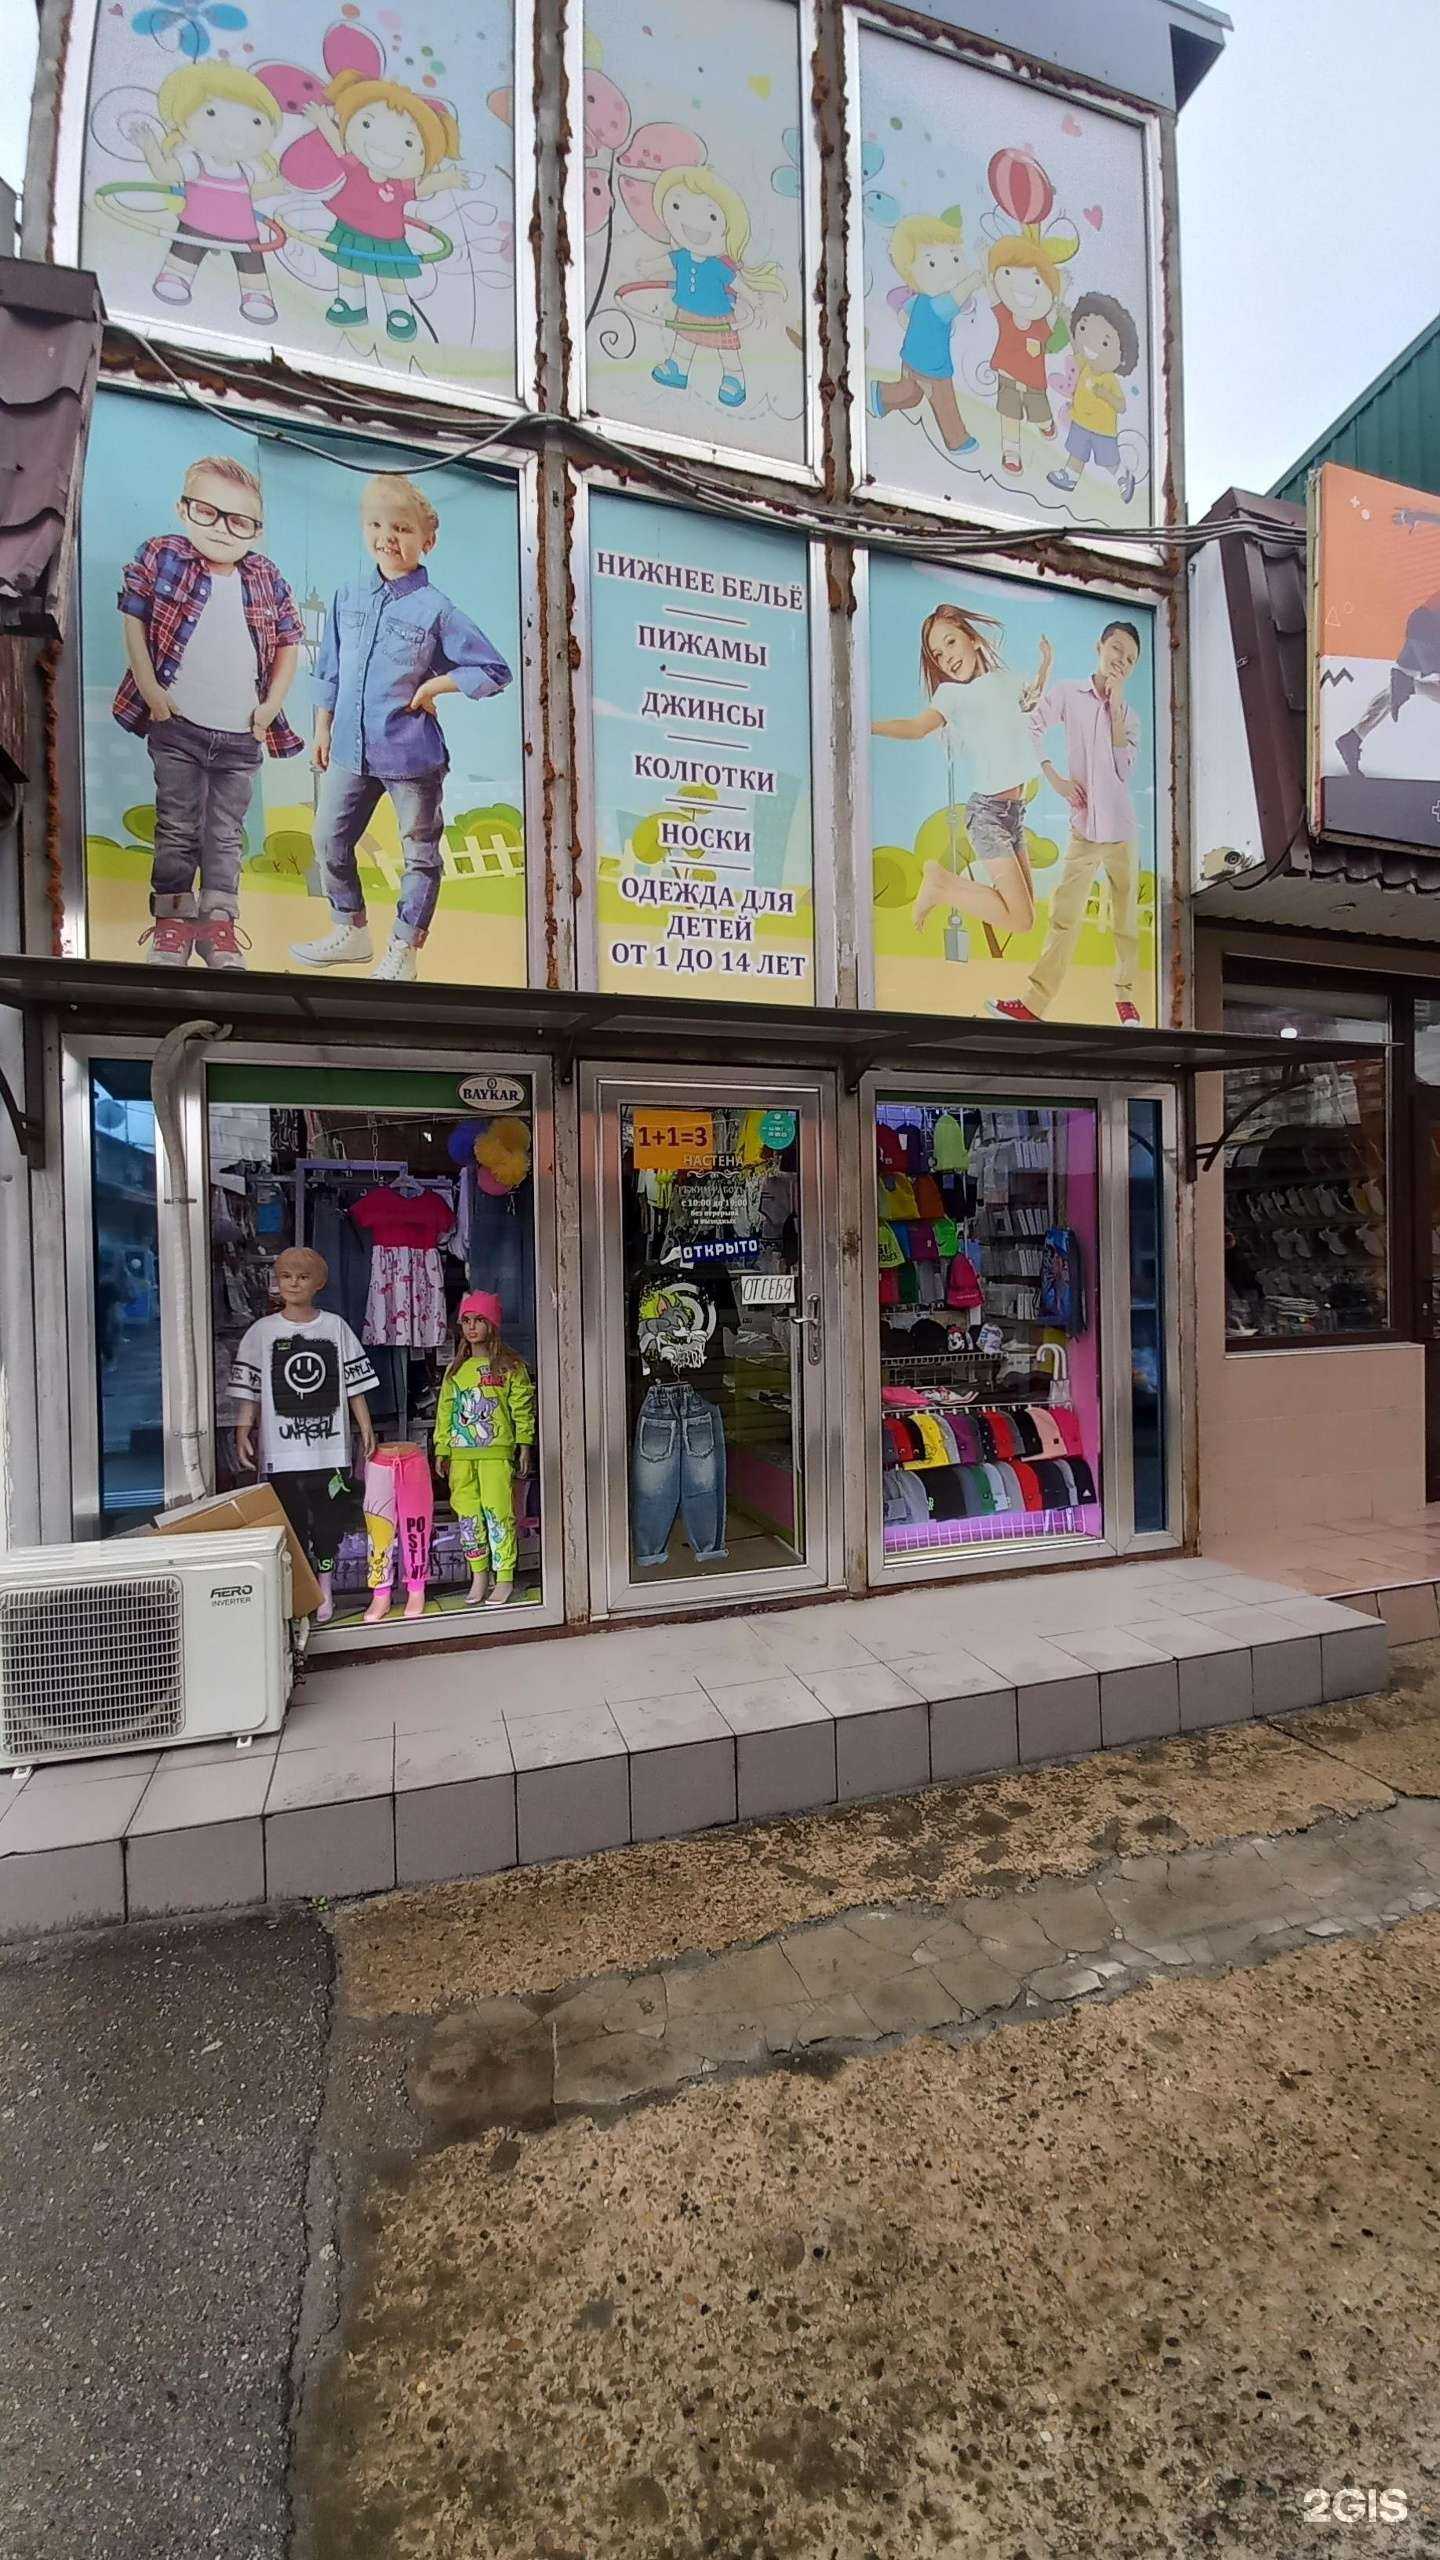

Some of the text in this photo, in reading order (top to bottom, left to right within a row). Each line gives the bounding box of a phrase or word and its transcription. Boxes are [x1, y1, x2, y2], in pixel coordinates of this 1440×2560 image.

[597, 552, 803, 610] НИЖНЕЕ БЕЛЬЁ
[638, 624, 767, 667] ПИЖАМЫ
[641, 691, 765, 729] ДЖИНСЫ
[634, 755, 774, 793] КОЛГОТКИ
[661, 823, 751, 852] НОСКИ
[621, 877, 794, 914] ОДЕЖДА ДЛЯ
[666, 915, 752, 942] ДЕТЕЙ
[611, 943, 806, 977] ОТ 1 ДО 14 ЛЕТ
[463, 1088, 520, 1102] BAYKAR
[638, 1126, 708, 1147] 1+1=3
[684, 1153, 743, 1168] НАСТЕНА
[683, 1239, 758, 1259] ОТКРЫТО
[744, 1277, 793, 1301] ОТ СЕБЯ
